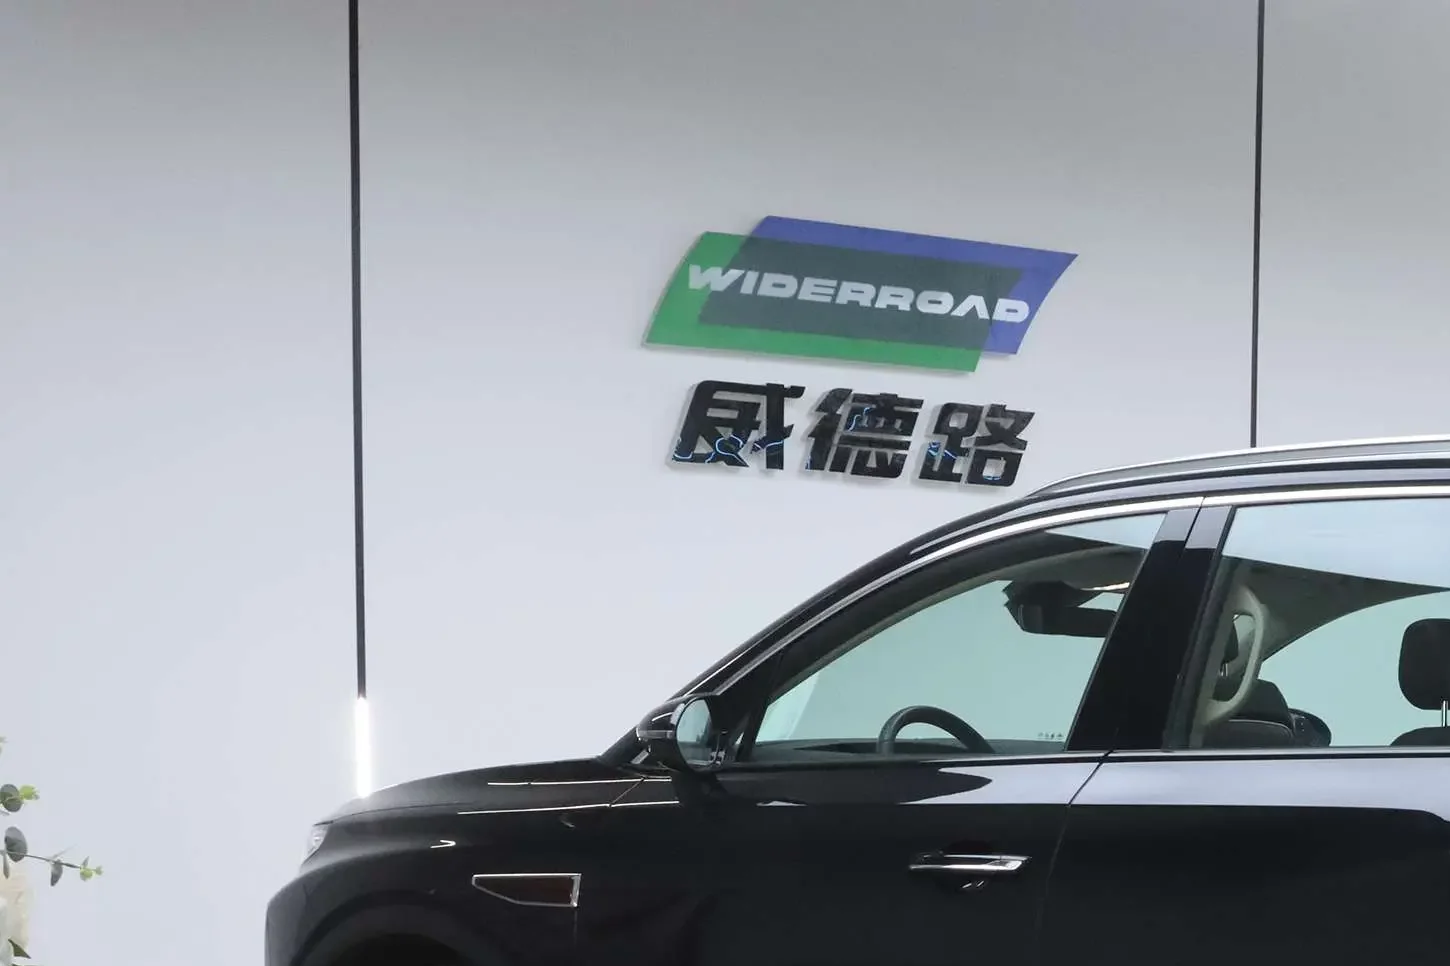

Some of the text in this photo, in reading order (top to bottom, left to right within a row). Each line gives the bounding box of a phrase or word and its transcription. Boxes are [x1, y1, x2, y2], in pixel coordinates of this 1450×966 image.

[686, 263, 1031, 324] WIDERROAD
[671, 379, 1036, 488] 威德路
